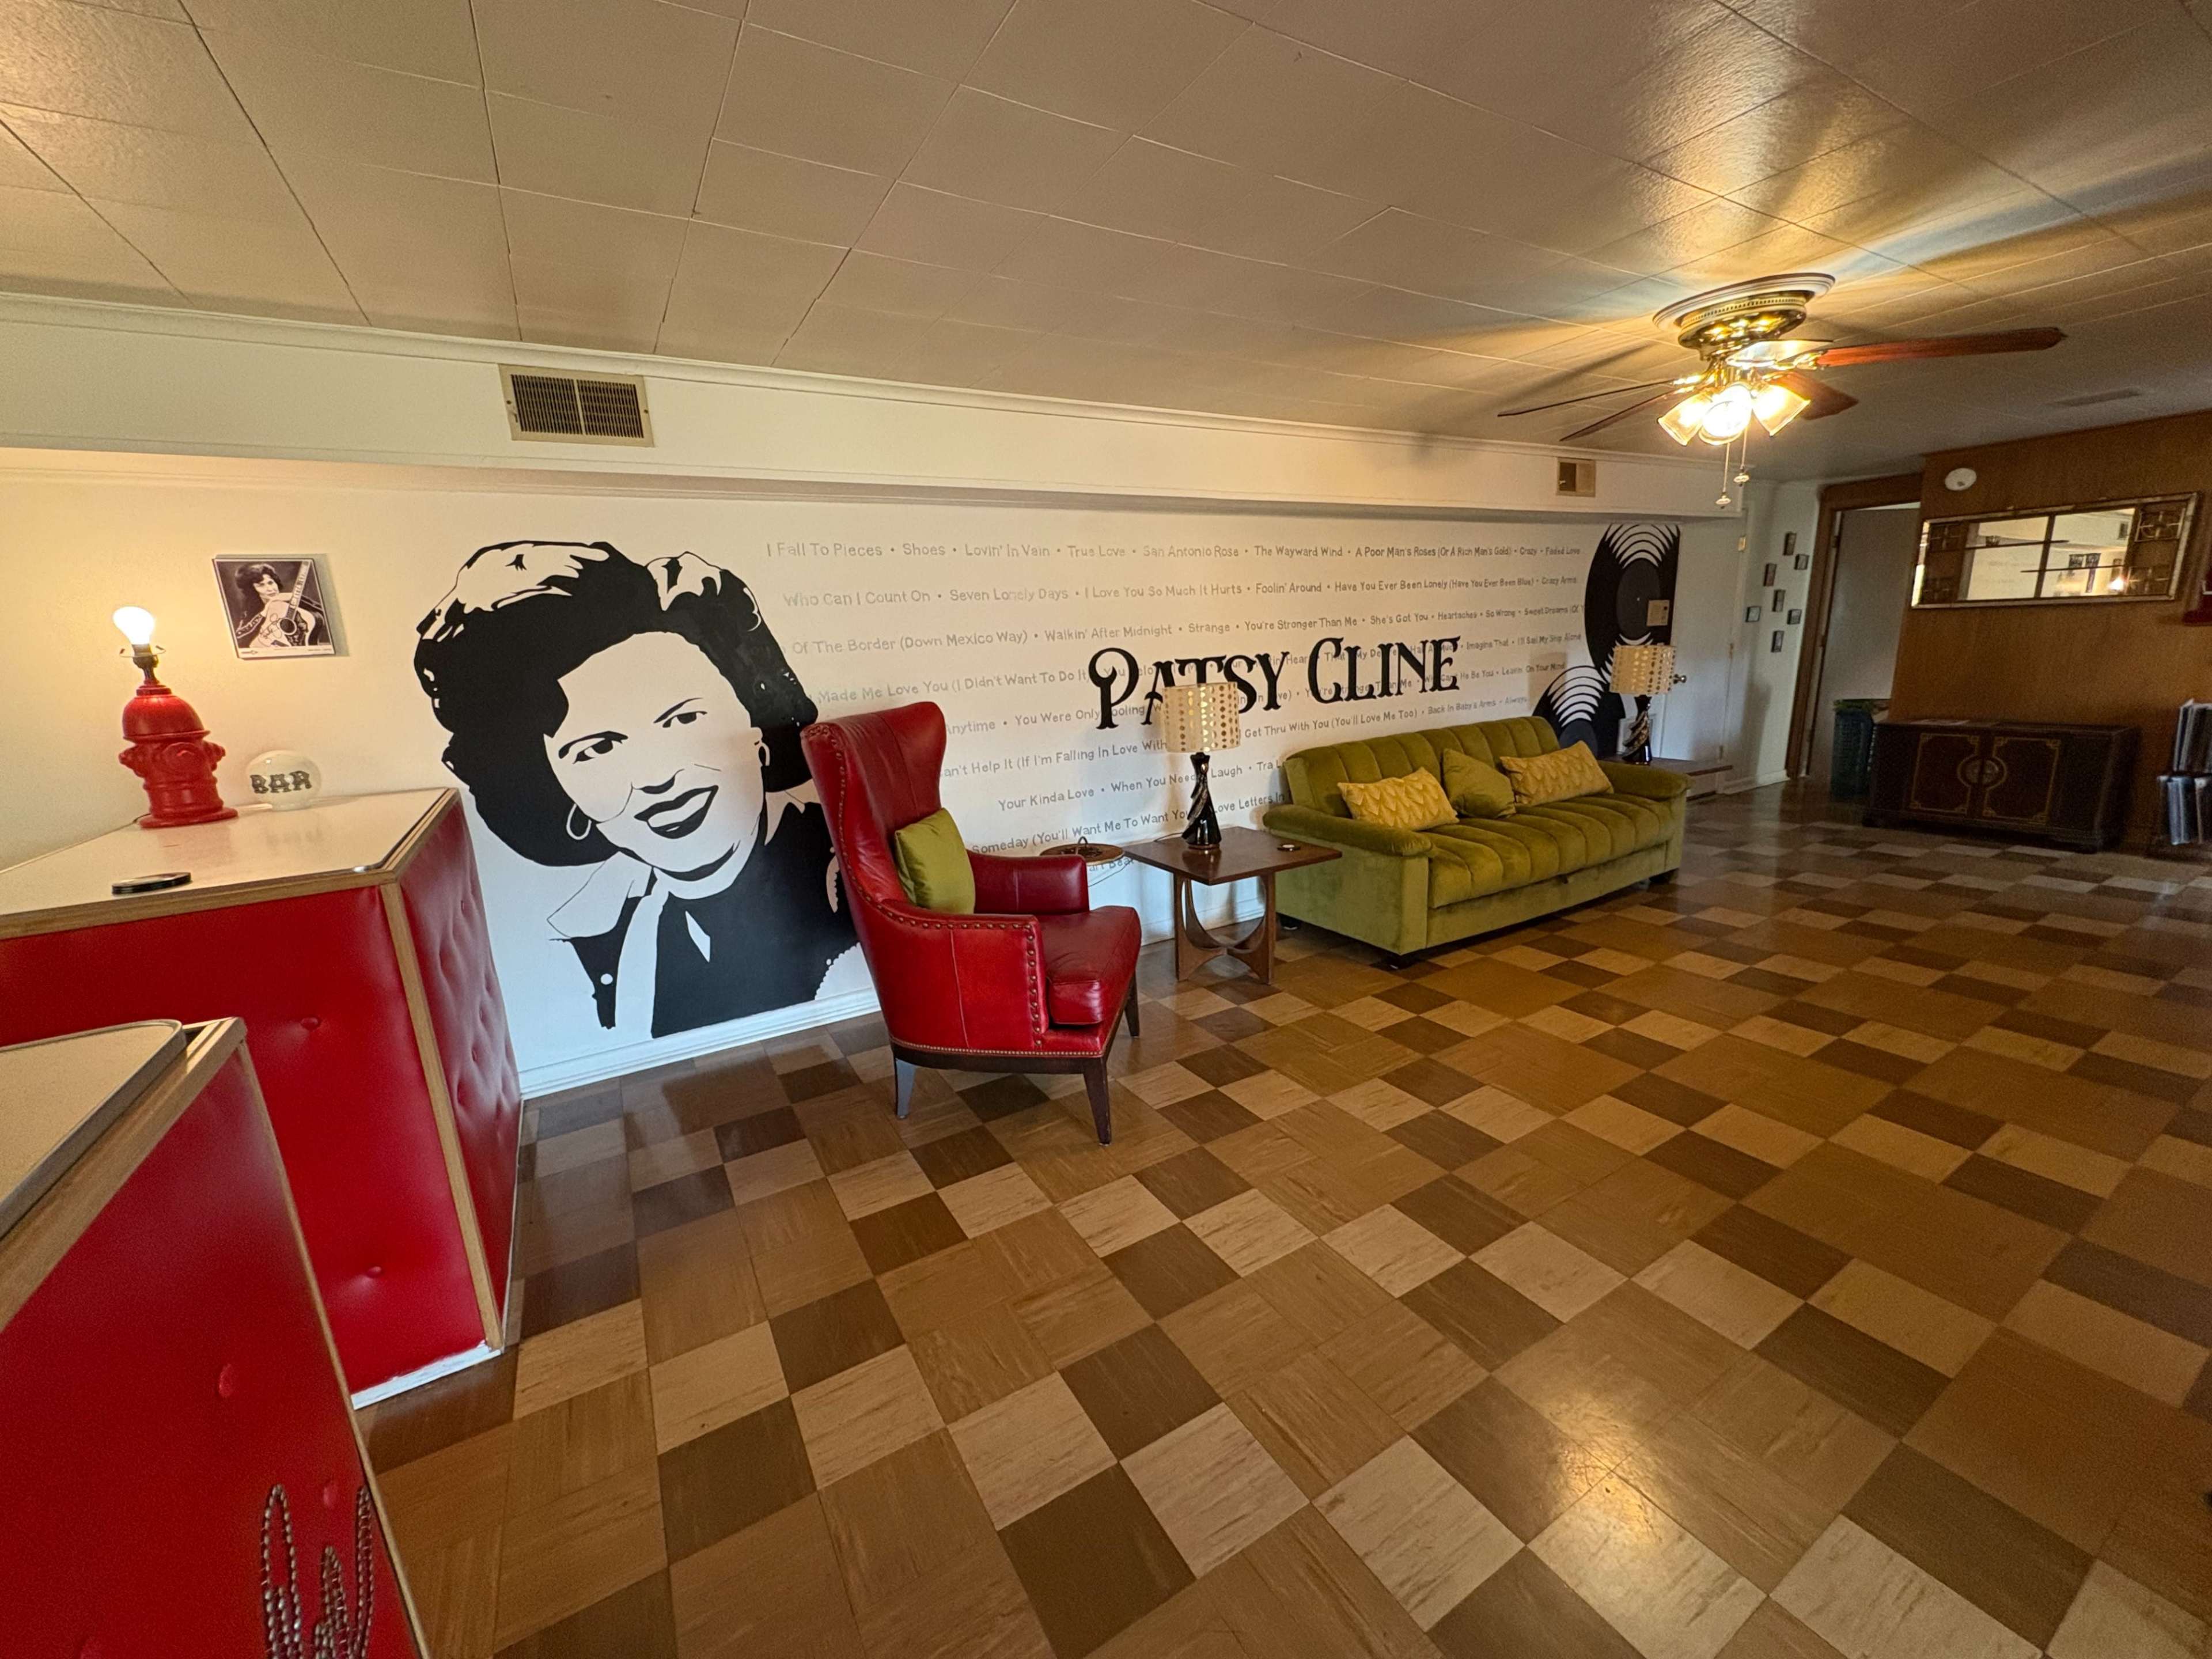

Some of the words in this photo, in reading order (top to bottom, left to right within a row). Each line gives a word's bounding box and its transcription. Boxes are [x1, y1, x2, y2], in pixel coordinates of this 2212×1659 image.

[767, 543, 771, 557] I
[777, 543, 805, 556] Fall
[810, 543, 830, 556] To
[834, 543, 882, 556] Pieces
[903, 543, 945, 556] Shoes
[965, 544, 1002, 557] Lovin'
[1007, 544, 1019, 557] In
[1021, 544, 1050, 557] Vain
[1067, 545, 1094, 558] True
[1099, 544, 1126, 557] Love
[1143, 545, 1165, 558] San
[1168, 545, 1212, 558] Antonio
[1214, 545, 1238, 557] Rose
[1253, 545, 1272, 557] The
[1275, 545, 1318, 558] Wayward
[1320, 546, 1343, 557] Wind
[1355, 546, 1363, 557] A
[1365, 546, 1383, 557] Poor
[1387, 546, 1411, 557] Man's
[1414, 546, 1436, 557] Roses
[1437, 546, 1450, 558] (Or
[1450, 546, 1456, 558] A
[1457, 546, 1473, 558] Rich
[1474, 546, 1493, 558] Man's
[1520, 547, 1537, 557] Crazy
[1566, 547, 1581, 555] Love
[783, 592, 819, 606] Who
[823, 593, 853, 605] Can
[857, 592, 861, 605] I
[865, 591, 907, 604] Count
[911, 590, 930, 602] On
[950, 589, 990, 601] Seven
[994, 588, 1035, 602] Lonely
[1038, 588, 1069, 601] Days
[1084, 586, 1088, 599] I
[1093, 587, 1119, 599] Love
[1124, 586, 1144, 598] You
[1148, 586, 1162, 597] So
[1166, 585, 1196, 597] Much
[1200, 585, 1208, 596] It
[1211, 584, 1242, 596] Hurts
[1256, 582, 1287, 594] Foolin'
[1289, 581, 1322, 593] Around
[1334, 581, 1357, 592] Have
[1360, 581, 1376, 591] You
[1378, 579, 1398, 591] Ever
[1400, 579, 1422, 590] Been
[1423, 578, 1448, 591] Lonely
[1449, 578, 1469, 589] (Have
[1470, 577, 1483, 588] You
[1484, 578, 1498, 588] Ever
[1499, 577, 1516, 587] Been
[1540, 576, 1559, 586] Crazy
[792, 641, 807, 654] Of
[812, 640, 843, 654] The
[847, 638, 895, 652] Border
[900, 636, 942, 651] (Down
[945, 634, 993, 647] Mexico
[996, 630, 1028, 645] Way)
[1044, 628, 1088, 641] Walkin'
[1091, 627, 1120, 640] After
[1123, 624, 1173, 639] Midnight
[1188, 623, 1230, 636] Strange
[1244, 620, 1274, 631] You're
[1277, 618, 1317, 631] Stronger
[1319, 617, 1342, 628] Than
[1344, 616, 1358, 626] Me
[1370, 615, 1393, 626] She's
[1395, 613, 1411, 623] Got
[1415, 612, 1429, 622] You
[1438, 610, 1478, 620] Heartaches
[1485, 609, 1495, 618] So
[1497, 609, 1516, 618] Wrong
[819, 689, 857, 703] Made
[862, 688, 883, 700] Me
[887, 684, 918, 697] Love
[923, 680, 948, 693] You
[964, 676, 1002, 690] Didn't
[1004, 674, 1037, 686] Want
[1039, 672, 1056, 684] To
[1058, 670, 1075, 682] Do
[1015, 715, 1037, 726] You
[1040, 713, 1072, 724] Were
[1075, 709, 1101, 721] Only
[1481, 669, 1494, 679] You
[1088, 647, 1290, 730] PATSY
[1308, 635, 1461, 704] CLINE
[972, 762, 1001, 775] Help
[1004, 759, 1013, 770] It
[1017, 755, 1030, 770] (If
[1034, 755, 1052, 767] I'm
[1056, 749, 1094, 763] Falling
[1098, 746, 1109, 758] In
[1112, 745, 1138, 757] Love
[1142, 740, 1168, 752] With
[1245, 727, 1262, 738] Get
[1264, 725, 1286, 736] Thru
[1289, 721, 1310, 733] With
[1312, 719, 1330, 730] You
[1331, 716, 1358, 730] (You'll
[1360, 714, 1381, 725] Love
[1383, 712, 1396, 721] Me
[1398, 708, 1418, 719] Too)
[1427, 706, 1446, 715] Back
[1447, 704, 1455, 713] In
[250, 770, 313, 794] BAR
[998, 798, 1027, 812] Your
[1030, 793, 1065, 807] Kinda
[1067, 788, 1095, 800] Love
[1111, 781, 1143, 793] When
[1146, 777, 1166, 788] You
[1211, 765, 1243, 779] Laugh
[1256, 762, 1274, 772] Tra
[972, 838, 1029, 855] Someday
[1032, 831, 1069, 847] (You'll
[1071, 825, 1102, 837] Want
[1104, 821, 1122, 833] Me
[1123, 817, 1138, 828] To
[1141, 813, 1169, 824] Want
[1238, 796, 1274, 811] Letters
